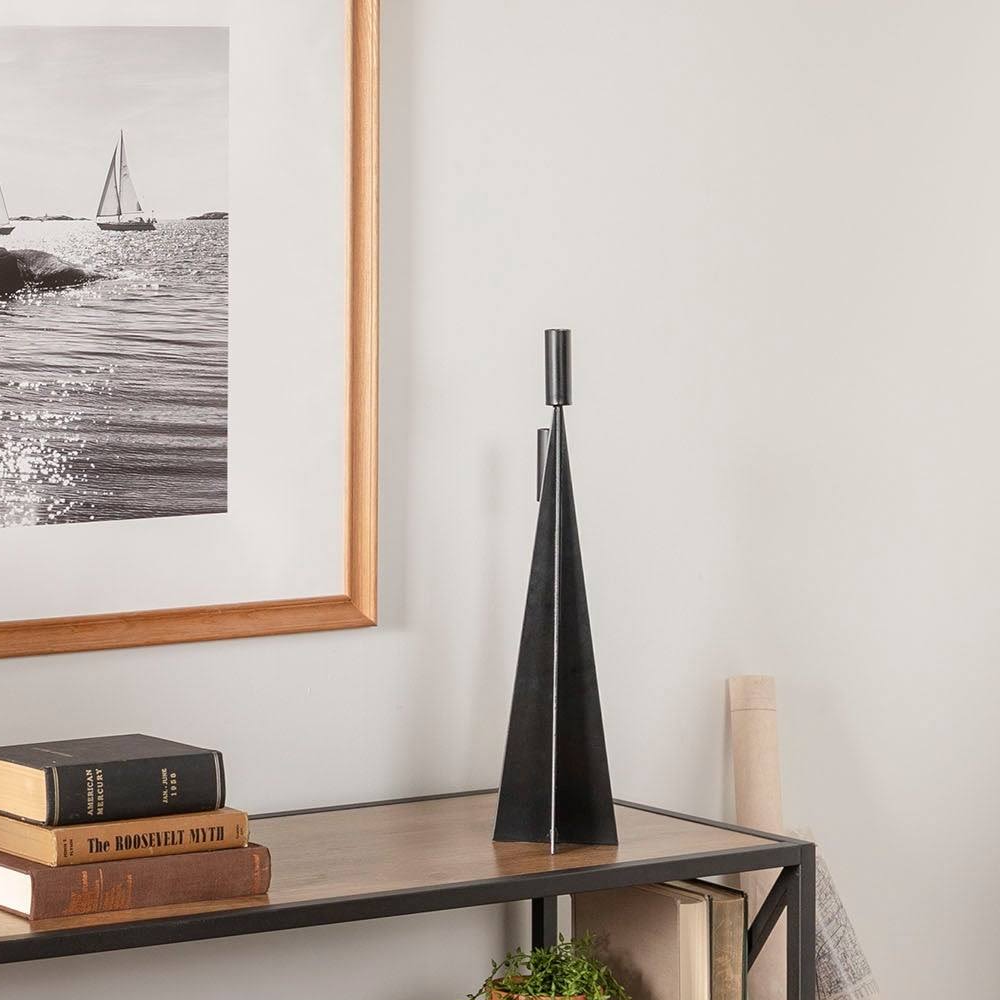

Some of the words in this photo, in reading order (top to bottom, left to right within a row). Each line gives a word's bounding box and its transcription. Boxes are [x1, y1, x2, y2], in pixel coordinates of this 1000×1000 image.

[85, 769, 94, 816] AMERICAN
[95, 768, 104, 816] MERCURY
[87, 838, 110, 853] The
[115, 830, 184, 851] ROOSEVELT
[190, 826, 225, 843] MYTH
